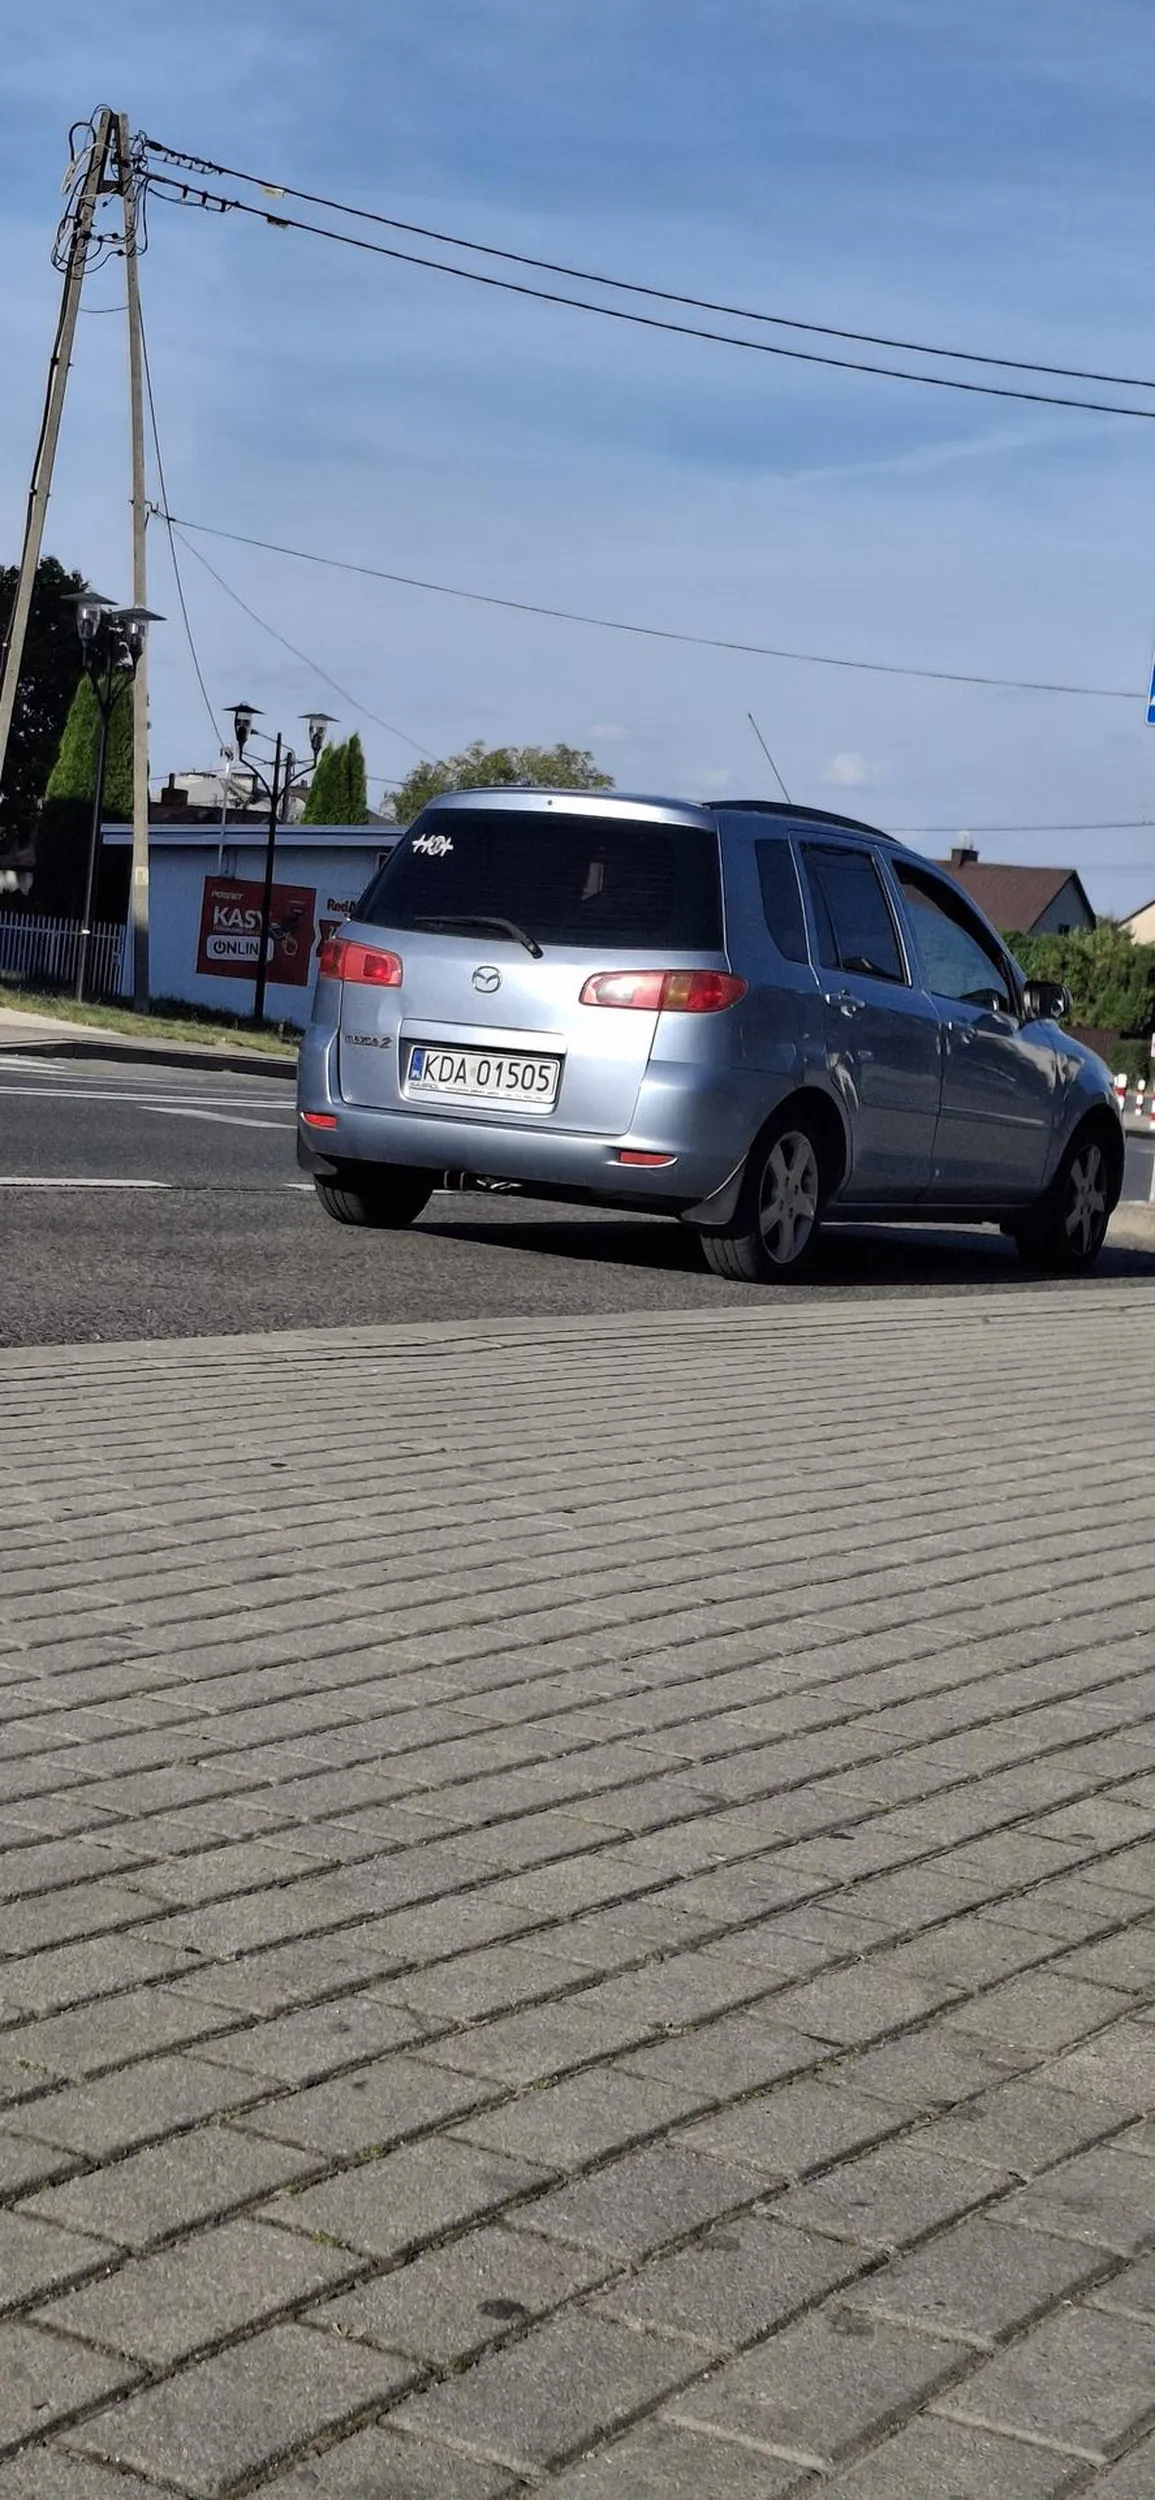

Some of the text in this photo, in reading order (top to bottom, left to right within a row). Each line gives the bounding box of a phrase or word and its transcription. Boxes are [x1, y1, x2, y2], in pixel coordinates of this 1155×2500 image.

[213, 940, 260, 956] ONLIN
[423, 1054, 552, 1092] KDA 01505
